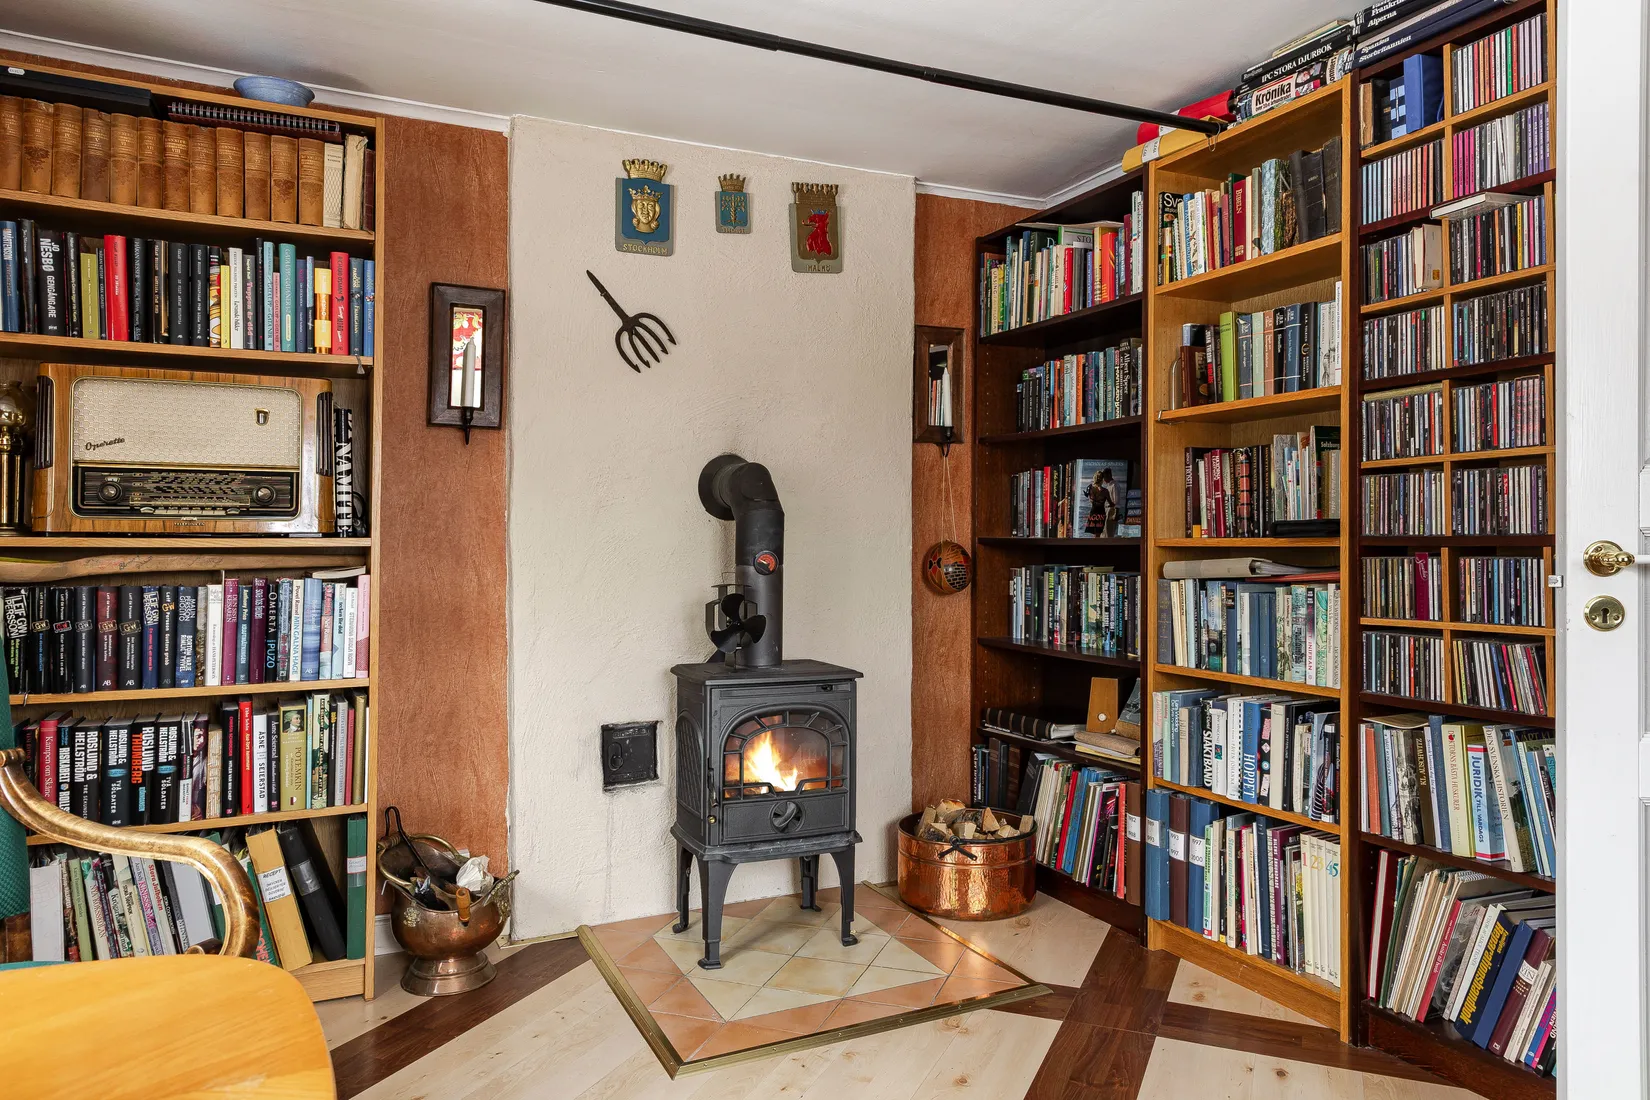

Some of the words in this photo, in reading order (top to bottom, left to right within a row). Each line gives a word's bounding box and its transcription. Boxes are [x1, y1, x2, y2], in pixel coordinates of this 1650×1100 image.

[1368, 11, 1397, 27] Alperna
[1359, 35, 1412, 63] Storbritannien
[1361, 36, 1390, 54] Spanien
[1262, 71, 1273, 83] IPC
[1272, 61, 1297, 78] STORA
[1298, 43, 1332, 66] DJURBOK
[1255, 81, 1291, 106] Krönika
[1235, 188, 1243, 214] BIBELN
[40, 238, 55, 272] NESBØ
[51, 242, 60, 252] JO
[623, 243, 667, 255] STOCKHOLM
[46, 275, 57, 318] GENGÅNGARE
[247, 311, 253, 320] är
[10, 596, 26, 616] LEIF
[142, 594, 153, 625] PERSSON
[149, 592, 159, 609] LEIF
[162, 602, 175, 612] GW
[268, 592, 278, 633] OMERTÀ
[4, 599, 19, 637] PERSSON
[16, 616, 28, 634] GW
[122, 622, 137, 632] GW
[151, 609, 159, 622] GW
[266, 643, 276, 669] PUZO
[291, 655, 299, 675] HAGE
[168, 726, 178, 755] ROSLUND
[258, 731, 266, 749] ÅSNE
[271, 720, 279, 734] Åsne
[1485, 728, 1495, 745] DEN
[44, 736, 54, 764] Kampen
[74, 732, 86, 782] HELLSTRÖM
[86, 731, 98, 772] ROSLUND
[108, 730, 119, 766] HELLSTRÖM
[118, 730, 127, 757] ROSLUND
[142, 726, 154, 771] ROSLUND
[158, 727, 170, 762] HELLSTRÖM
[1416, 737, 1426, 775] AUSCHWITZ
[44, 765, 51, 776] om
[58, 747, 71, 783] RISKABELT
[131, 733, 143, 784] THUNBERG
[294, 746, 302, 791] POTEMKIN
[1449, 764, 1459, 780] BÄSTA
[1487, 745, 1501, 779] SVENSKA
[44, 776, 53, 797] Skåne
[1242, 753, 1256, 799] HOPPET
[1470, 755, 1483, 799] JURIDIK
[110, 783, 118, 814] SOLDATER
[1451, 781, 1460, 811] HUSKURER
[1495, 780, 1509, 820] HISTORIEN
[1476, 814, 1484, 843] VARDAGS
[148, 864, 157, 882] Stora
[1301, 852, 1309, 867] 1
[150, 882, 164, 911] Julboken
[144, 913, 157, 928] MAT
[1459, 921, 1504, 1025] Reparationshandbok
[1519, 964, 1538, 981] VIN
